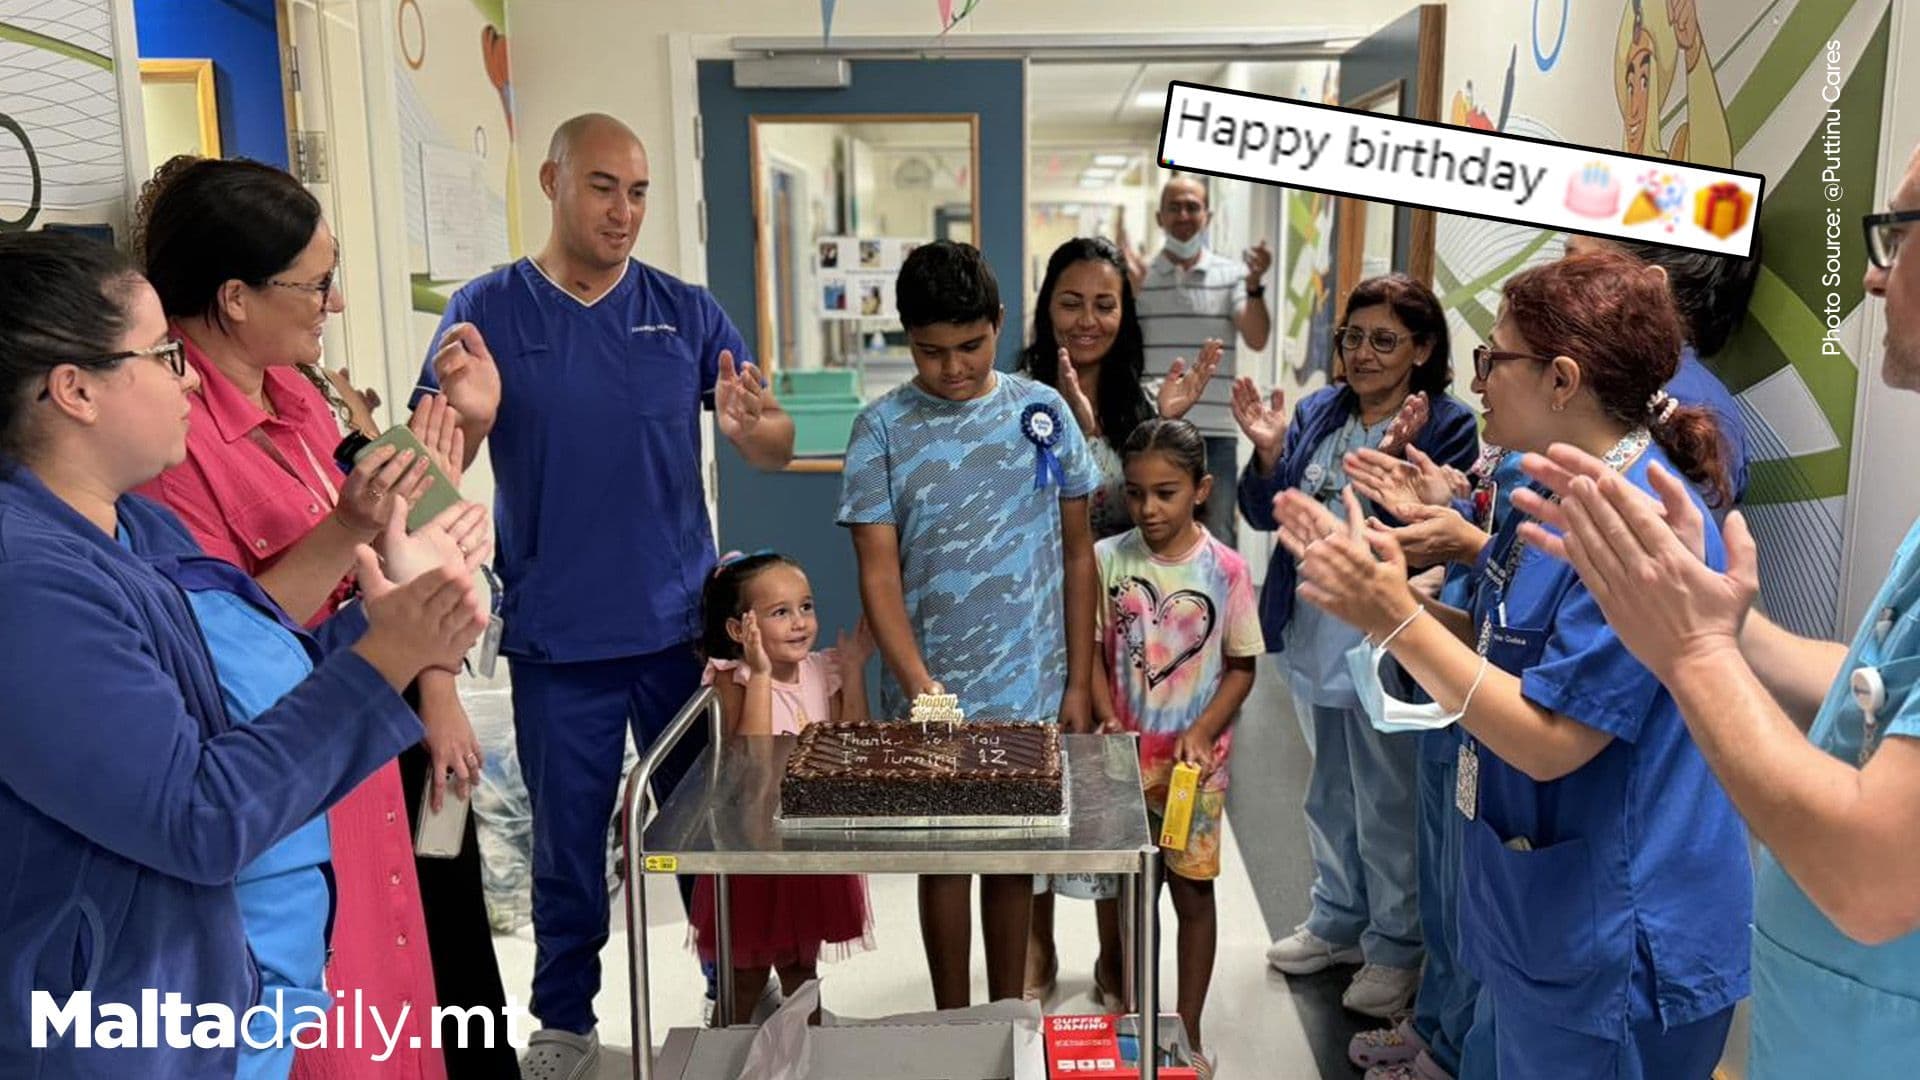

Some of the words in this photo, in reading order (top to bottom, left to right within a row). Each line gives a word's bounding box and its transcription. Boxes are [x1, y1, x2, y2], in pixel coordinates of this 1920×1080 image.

[966, 732, 1000, 745] You
[841, 748, 869, 764] I'm
[883, 749, 957, 774] Turning
[979, 748, 1009, 766] 12
